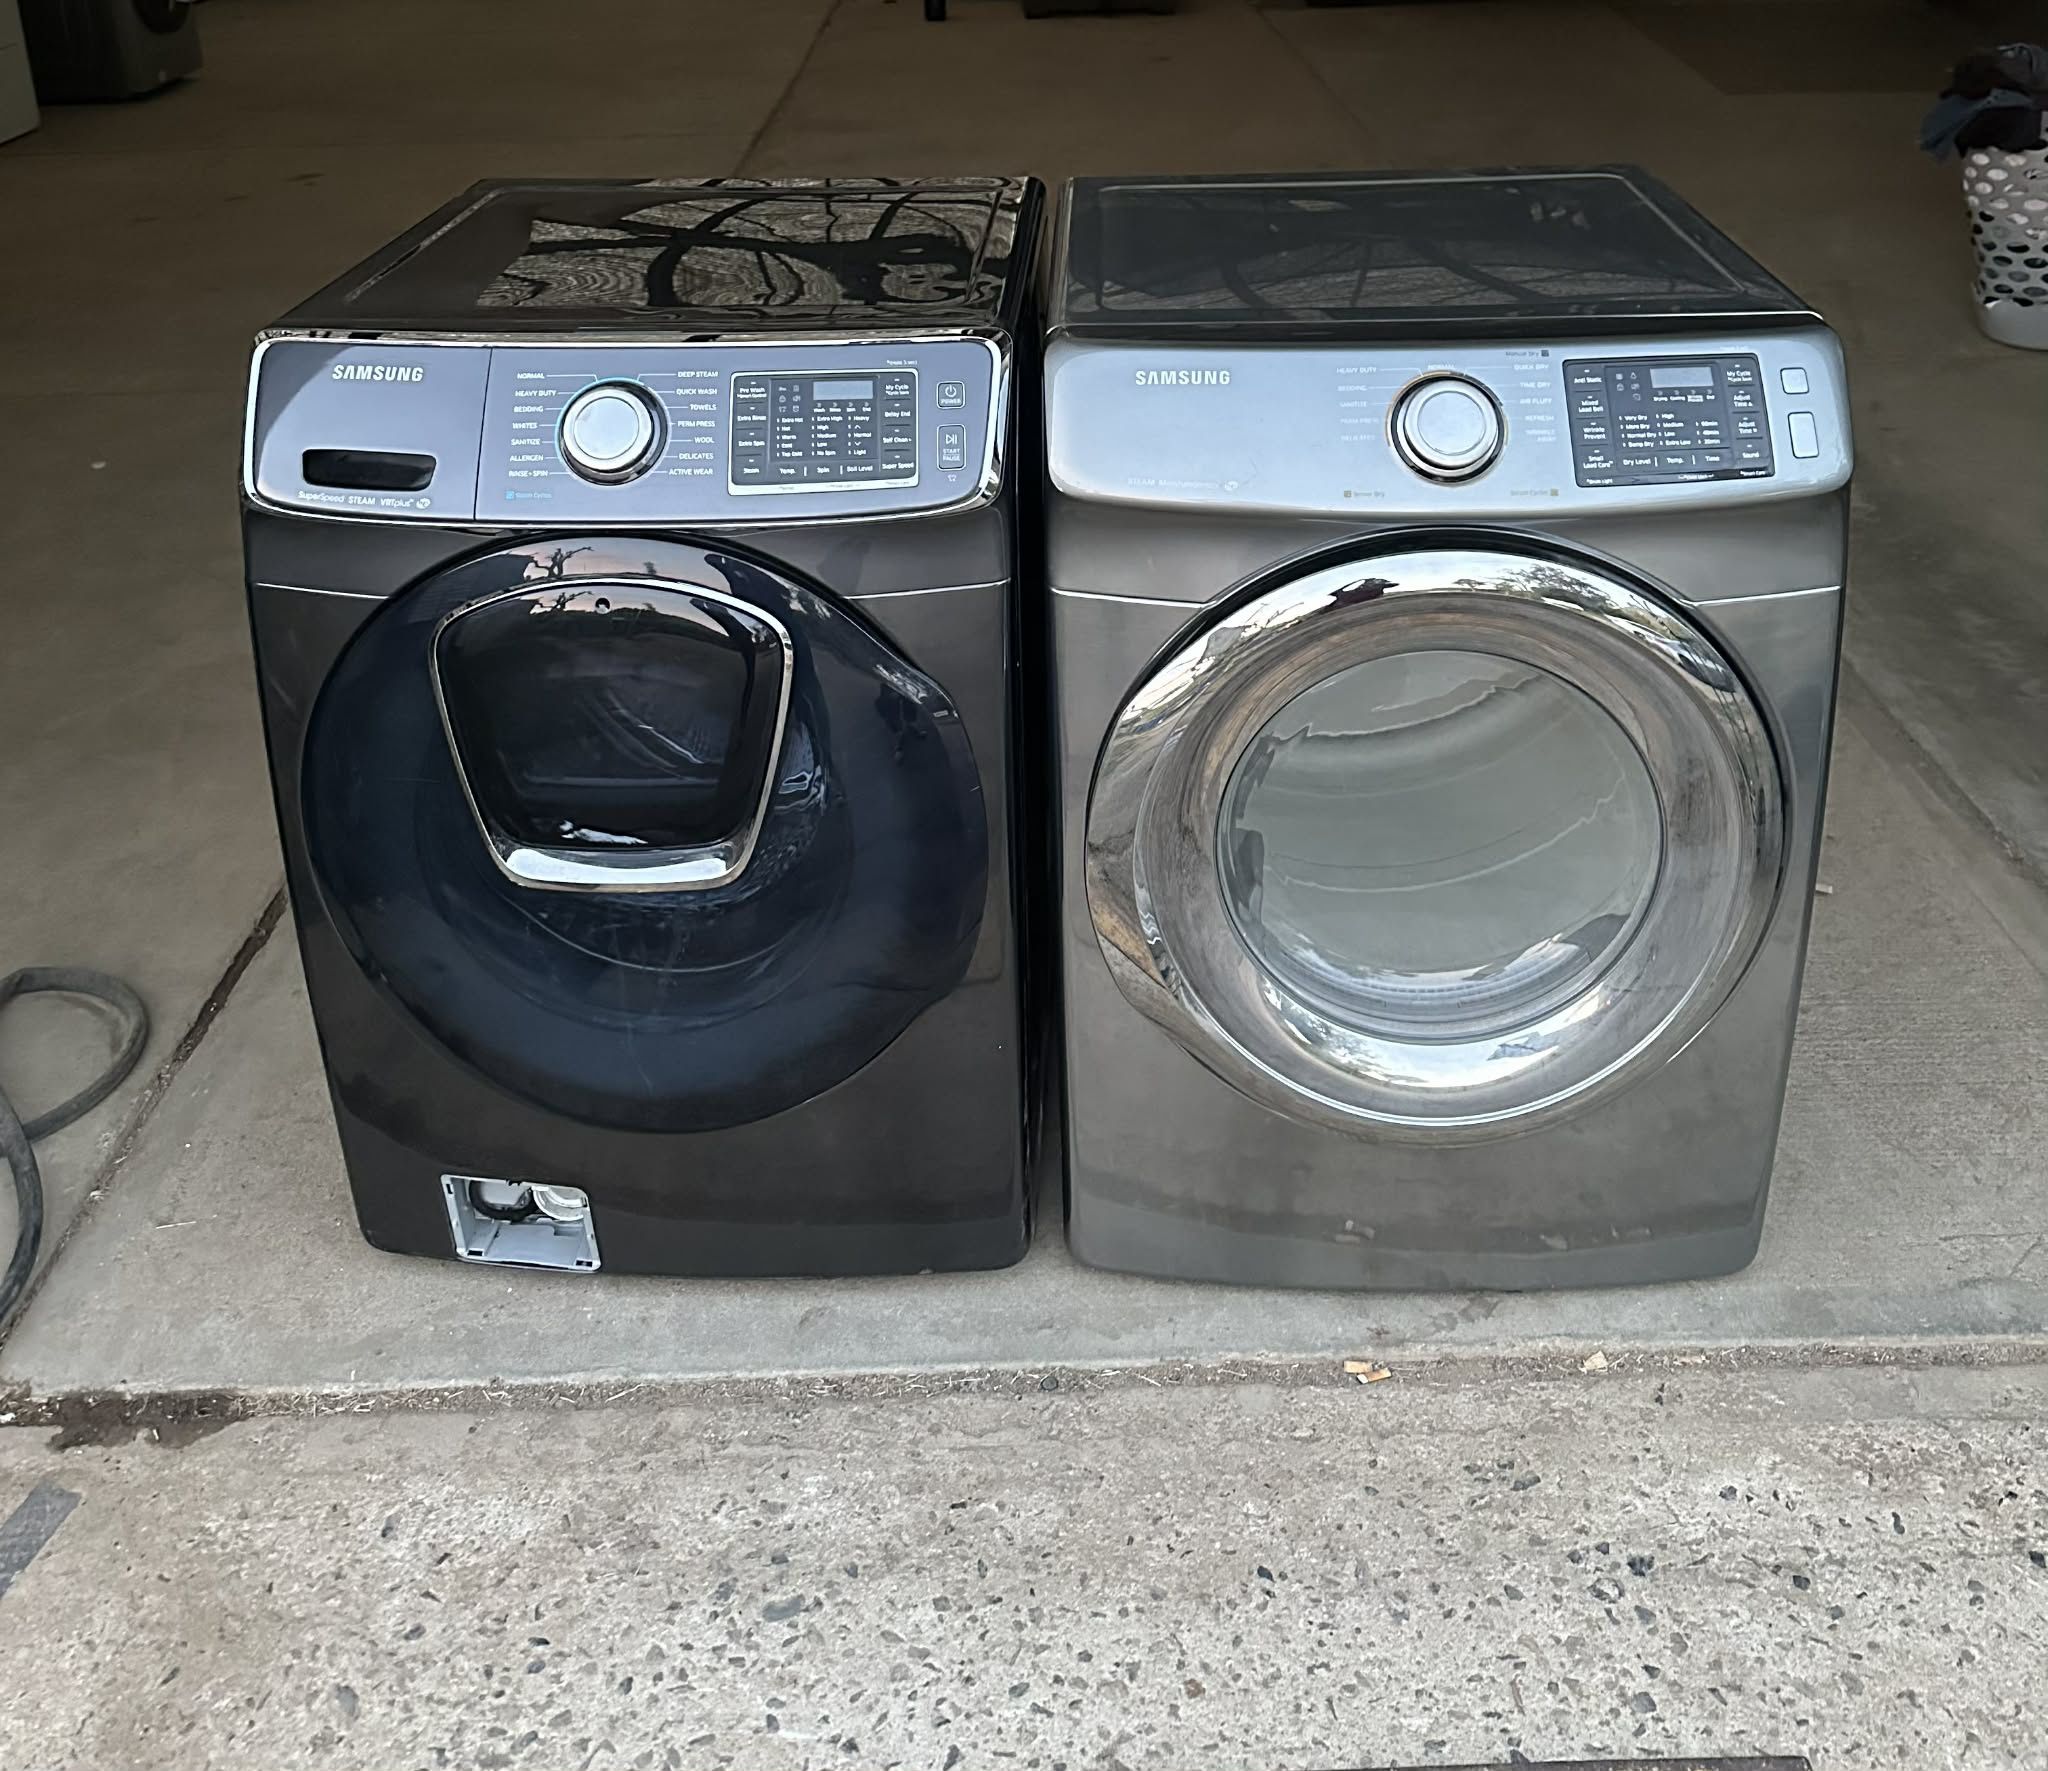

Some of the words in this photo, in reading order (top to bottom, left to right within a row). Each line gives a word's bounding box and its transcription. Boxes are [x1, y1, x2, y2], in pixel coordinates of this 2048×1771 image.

[332, 365, 424, 382] SAMSUNG
[1135, 370, 1231, 386] SAMSUNG
[348, 496, 376, 505] STEAM
